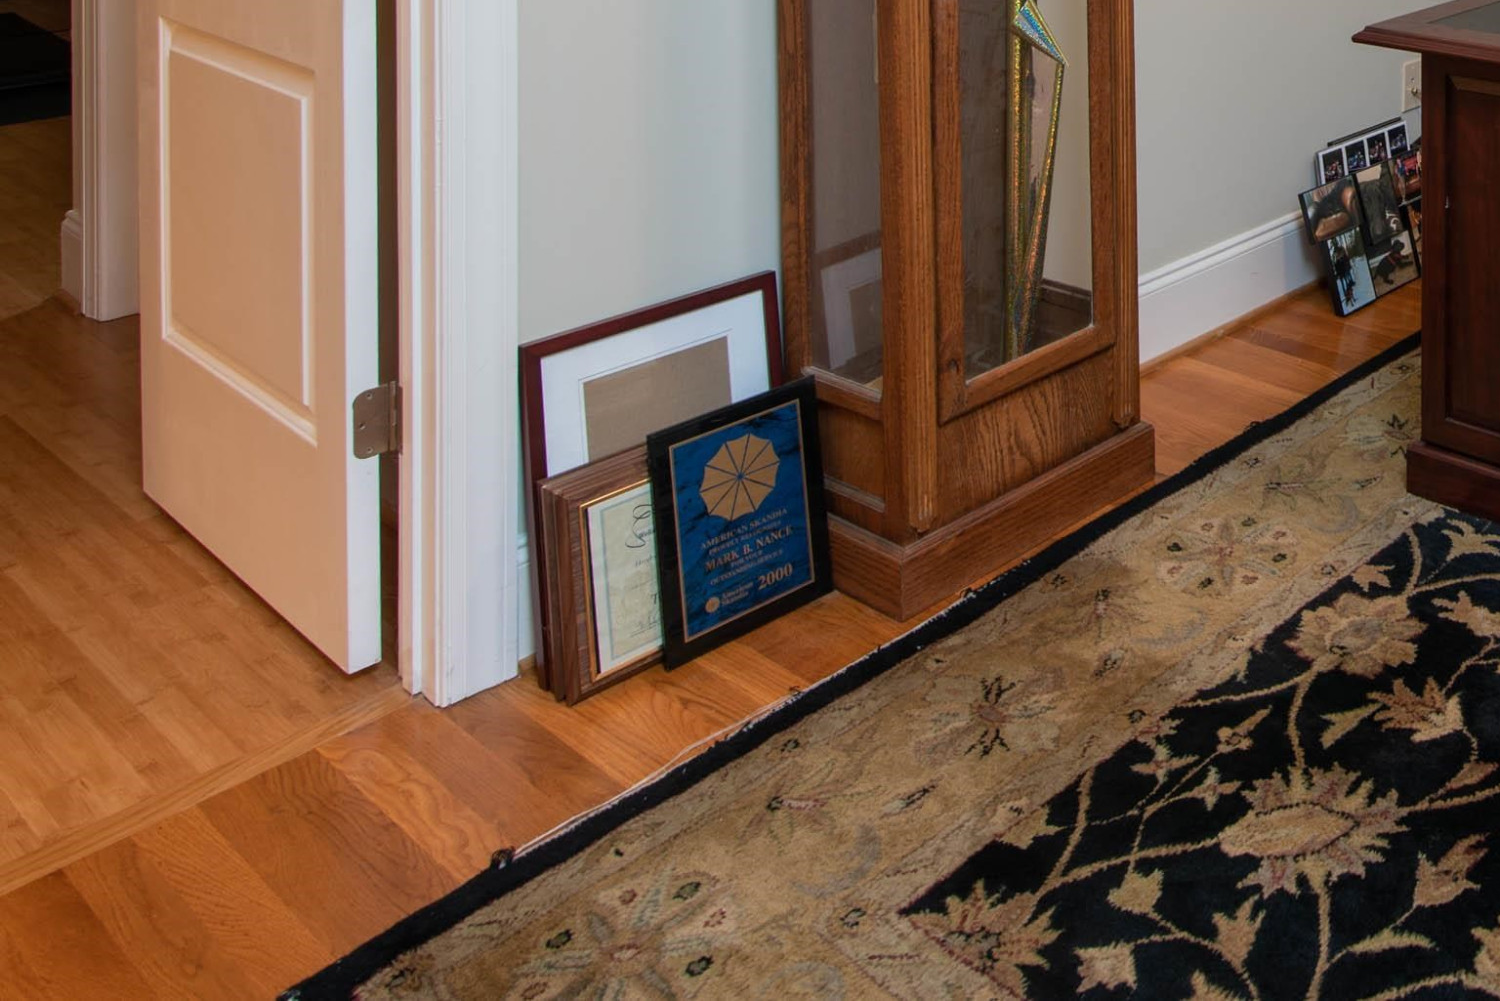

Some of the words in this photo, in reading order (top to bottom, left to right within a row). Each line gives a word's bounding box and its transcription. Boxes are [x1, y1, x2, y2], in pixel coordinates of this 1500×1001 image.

[701, 524, 748, 550] AMERICAN
[749, 507, 788, 529] SKANDIA
[705, 550, 740, 572] MARK
[742, 544, 753, 555] B.
[755, 524, 792, 547] NANCE
[758, 563, 793, 590] 2000
